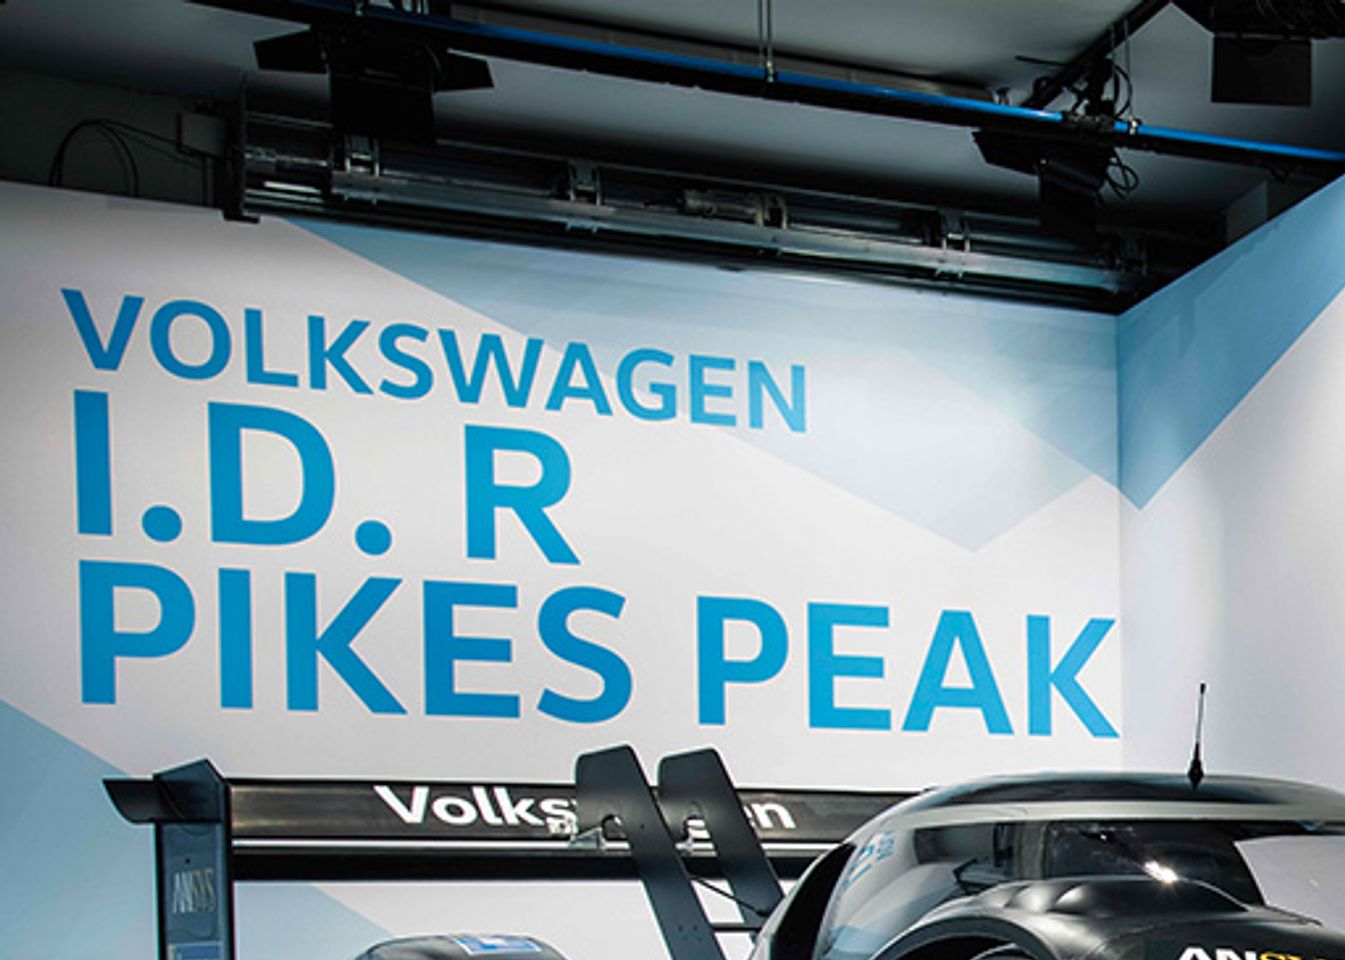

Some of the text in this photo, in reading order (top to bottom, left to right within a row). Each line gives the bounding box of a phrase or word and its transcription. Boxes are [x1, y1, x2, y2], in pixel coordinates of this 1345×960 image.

[61, 287, 806, 433] VOLKSWAGEN
[73, 389, 581, 566] I.D. R
[78, 559, 1120, 739] PIKES PEAK
[374, 785, 797, 839] Volksn
